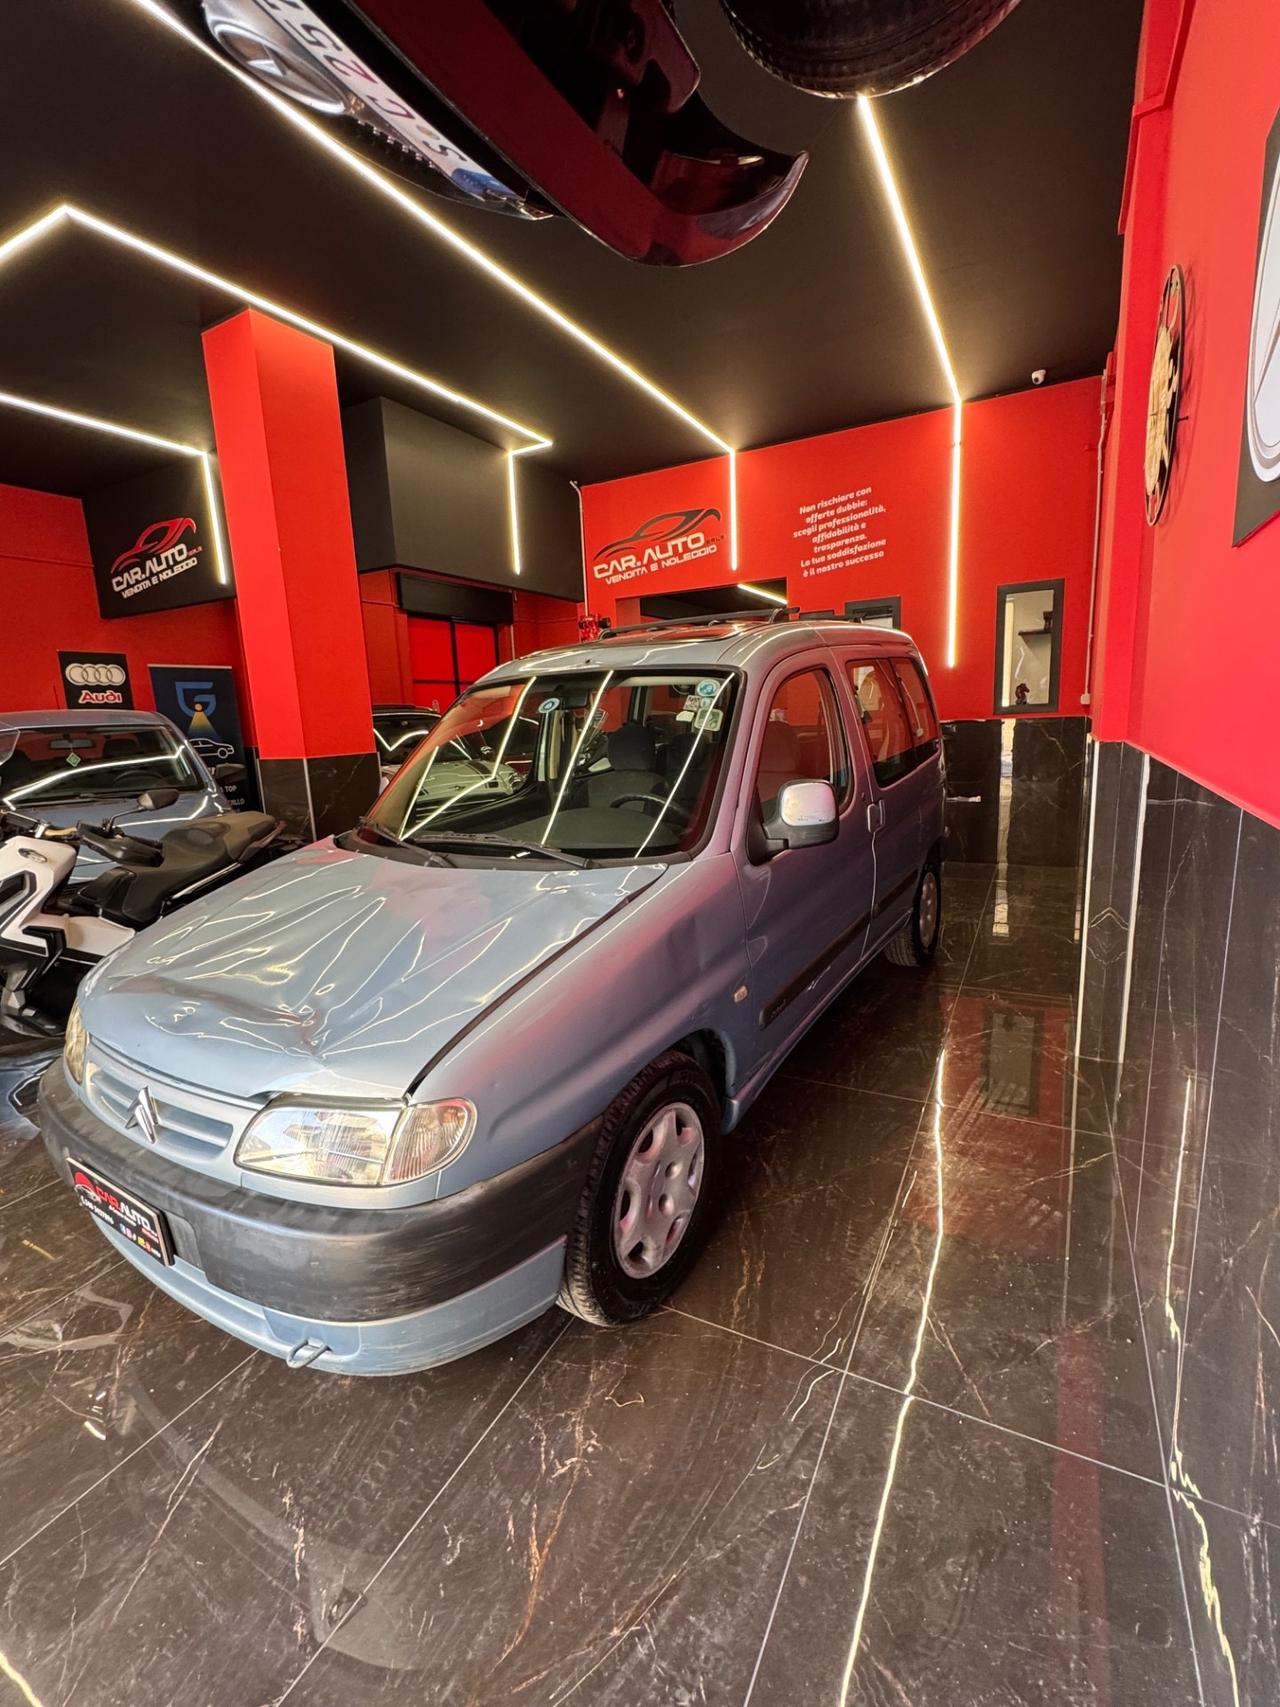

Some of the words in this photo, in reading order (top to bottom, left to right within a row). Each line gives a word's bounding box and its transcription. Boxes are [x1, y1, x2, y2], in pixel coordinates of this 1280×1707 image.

[816, 491, 855, 509] rischiare
[855, 486, 872, 497] con
[805, 509, 835, 524] offerte
[793, 524, 818, 538] scegli
[593, 531, 706, 580] CAR.AUTO
[800, 559, 811, 568] La
[811, 555, 826, 565] tua
[826, 538, 887, 560] soddisfazione
[816, 561, 844, 575] nostro
[844, 550, 885, 567] successo
[111, 543, 188, 592] CAR.AUTO
[605, 567, 648, 585] VENDITA
[650, 561, 659, 573] E
[121, 579, 152, 599] VENDITA
[150, 574, 160, 586] E
[78, 689, 123, 704] Audi
